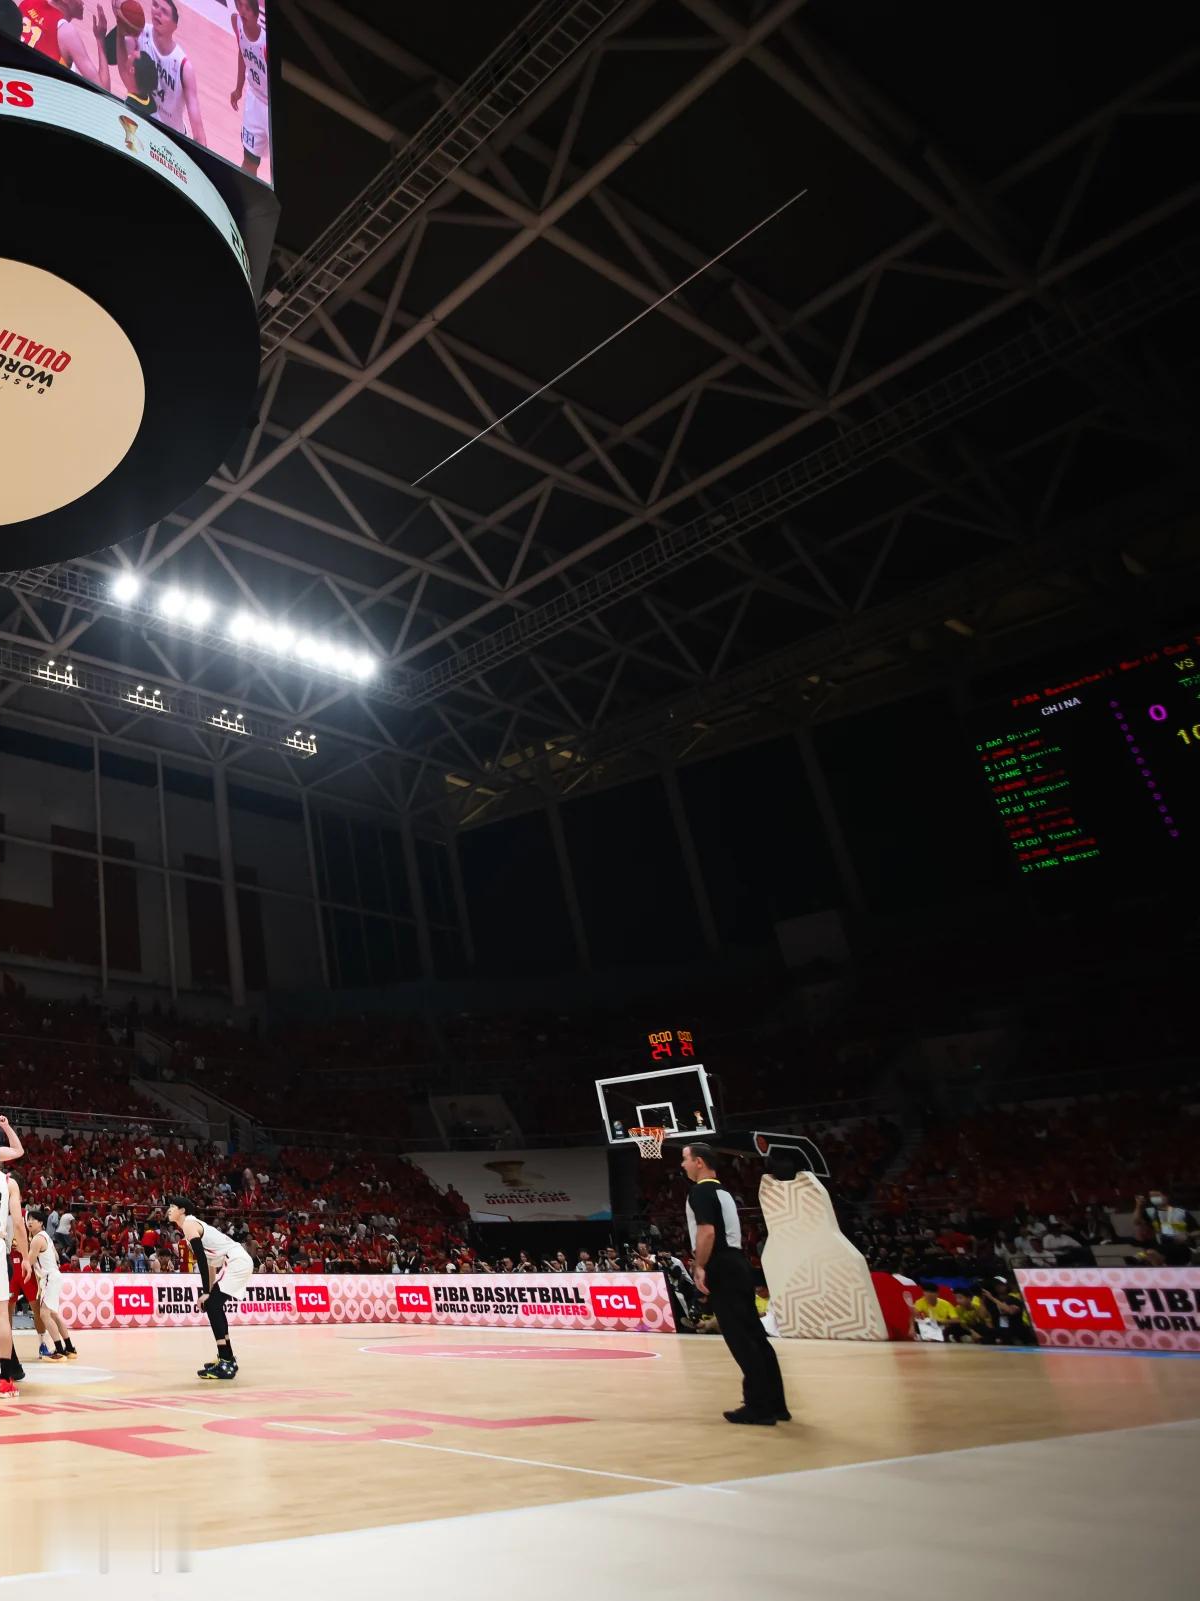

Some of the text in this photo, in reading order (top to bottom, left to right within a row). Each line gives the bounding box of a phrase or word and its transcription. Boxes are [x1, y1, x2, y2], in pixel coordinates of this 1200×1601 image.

[156, 61, 175, 91] PAN
[1040, 697, 1082, 716] CHINA
[118, 1294, 150, 1307] TCL
[157, 1287, 194, 1302] FIBA
[299, 1293, 326, 1306] TCL
[400, 1293, 428, 1306] TCL
[434, 1287, 585, 1304] FIBA BASKETBALL
[596, 1294, 636, 1310] TCL
[159, 1304, 191, 1314] WORLD
[222, 1303, 238, 1313] 027
[241, 1302, 293, 1313] QUALIFIERS
[436, 1303, 588, 1317] WORLD CUP 2027 QUALIFIERS
[1036, 1298, 1112, 1318] TCL
